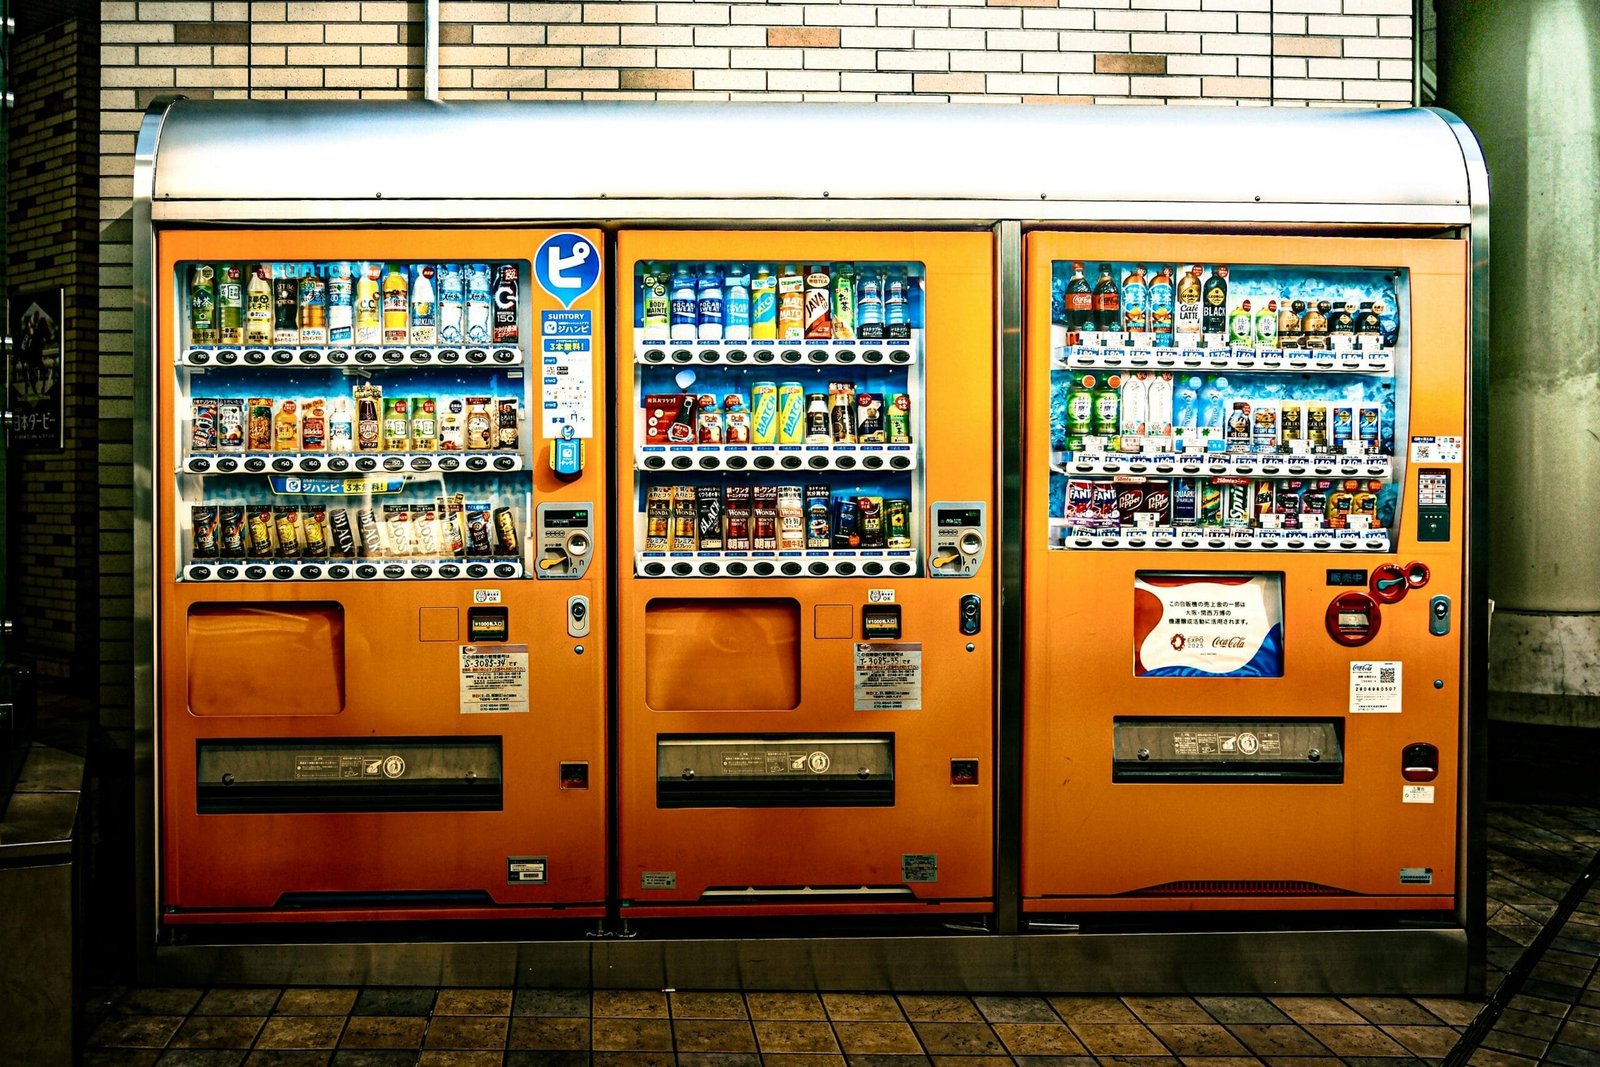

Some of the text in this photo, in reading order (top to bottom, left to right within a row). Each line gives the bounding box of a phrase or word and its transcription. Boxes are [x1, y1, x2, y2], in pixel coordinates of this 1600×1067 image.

[548, 241, 590, 288] ピ
[649, 300, 664, 308] BODY
[806, 292, 826, 318] JAVA
[1204, 307, 1226, 316] BLACK
[757, 396, 775, 437] MATCH
[784, 397, 802, 437] MATCH
[302, 484, 339, 492] ジハンピ
[1070, 489, 1092, 499] FANT
[1094, 490, 1116, 500] FANT
[1125, 493, 1135, 501] Dr
[1155, 493, 1164, 502] Dr
[700, 498, 720, 534] BLACK
[334, 514, 352, 552] BLACK
[362, 514, 380, 552] BLACK
[727, 539, 749, 549] 朝専用
[754, 539, 776, 549] 朝専用
